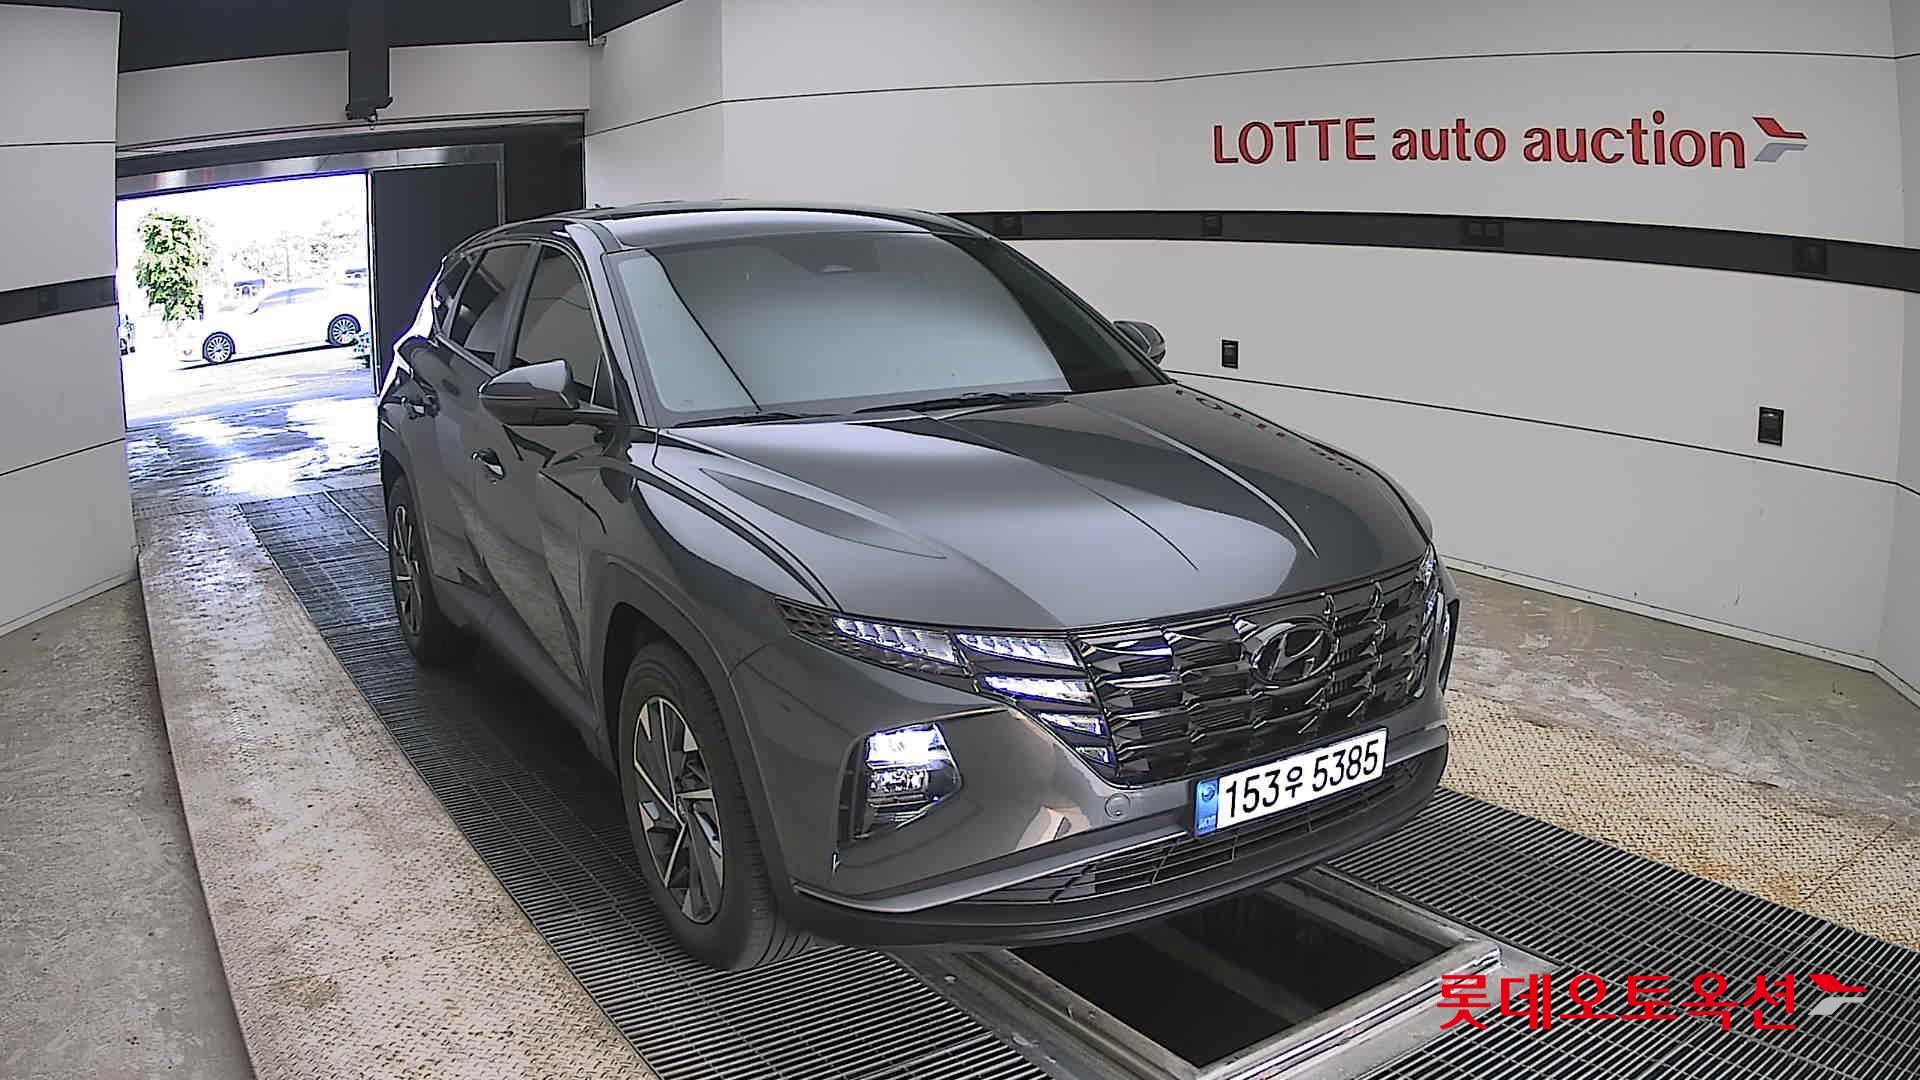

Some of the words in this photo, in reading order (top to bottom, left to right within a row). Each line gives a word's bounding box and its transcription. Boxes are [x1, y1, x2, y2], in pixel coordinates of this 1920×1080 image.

[1213, 117, 1376, 164] LOTTE
[1391, 118, 1507, 162] auto
[1523, 110, 1746, 169] auction
[1226, 766, 1303, 818] 153우
[1312, 739, 1379, 792] 5385
